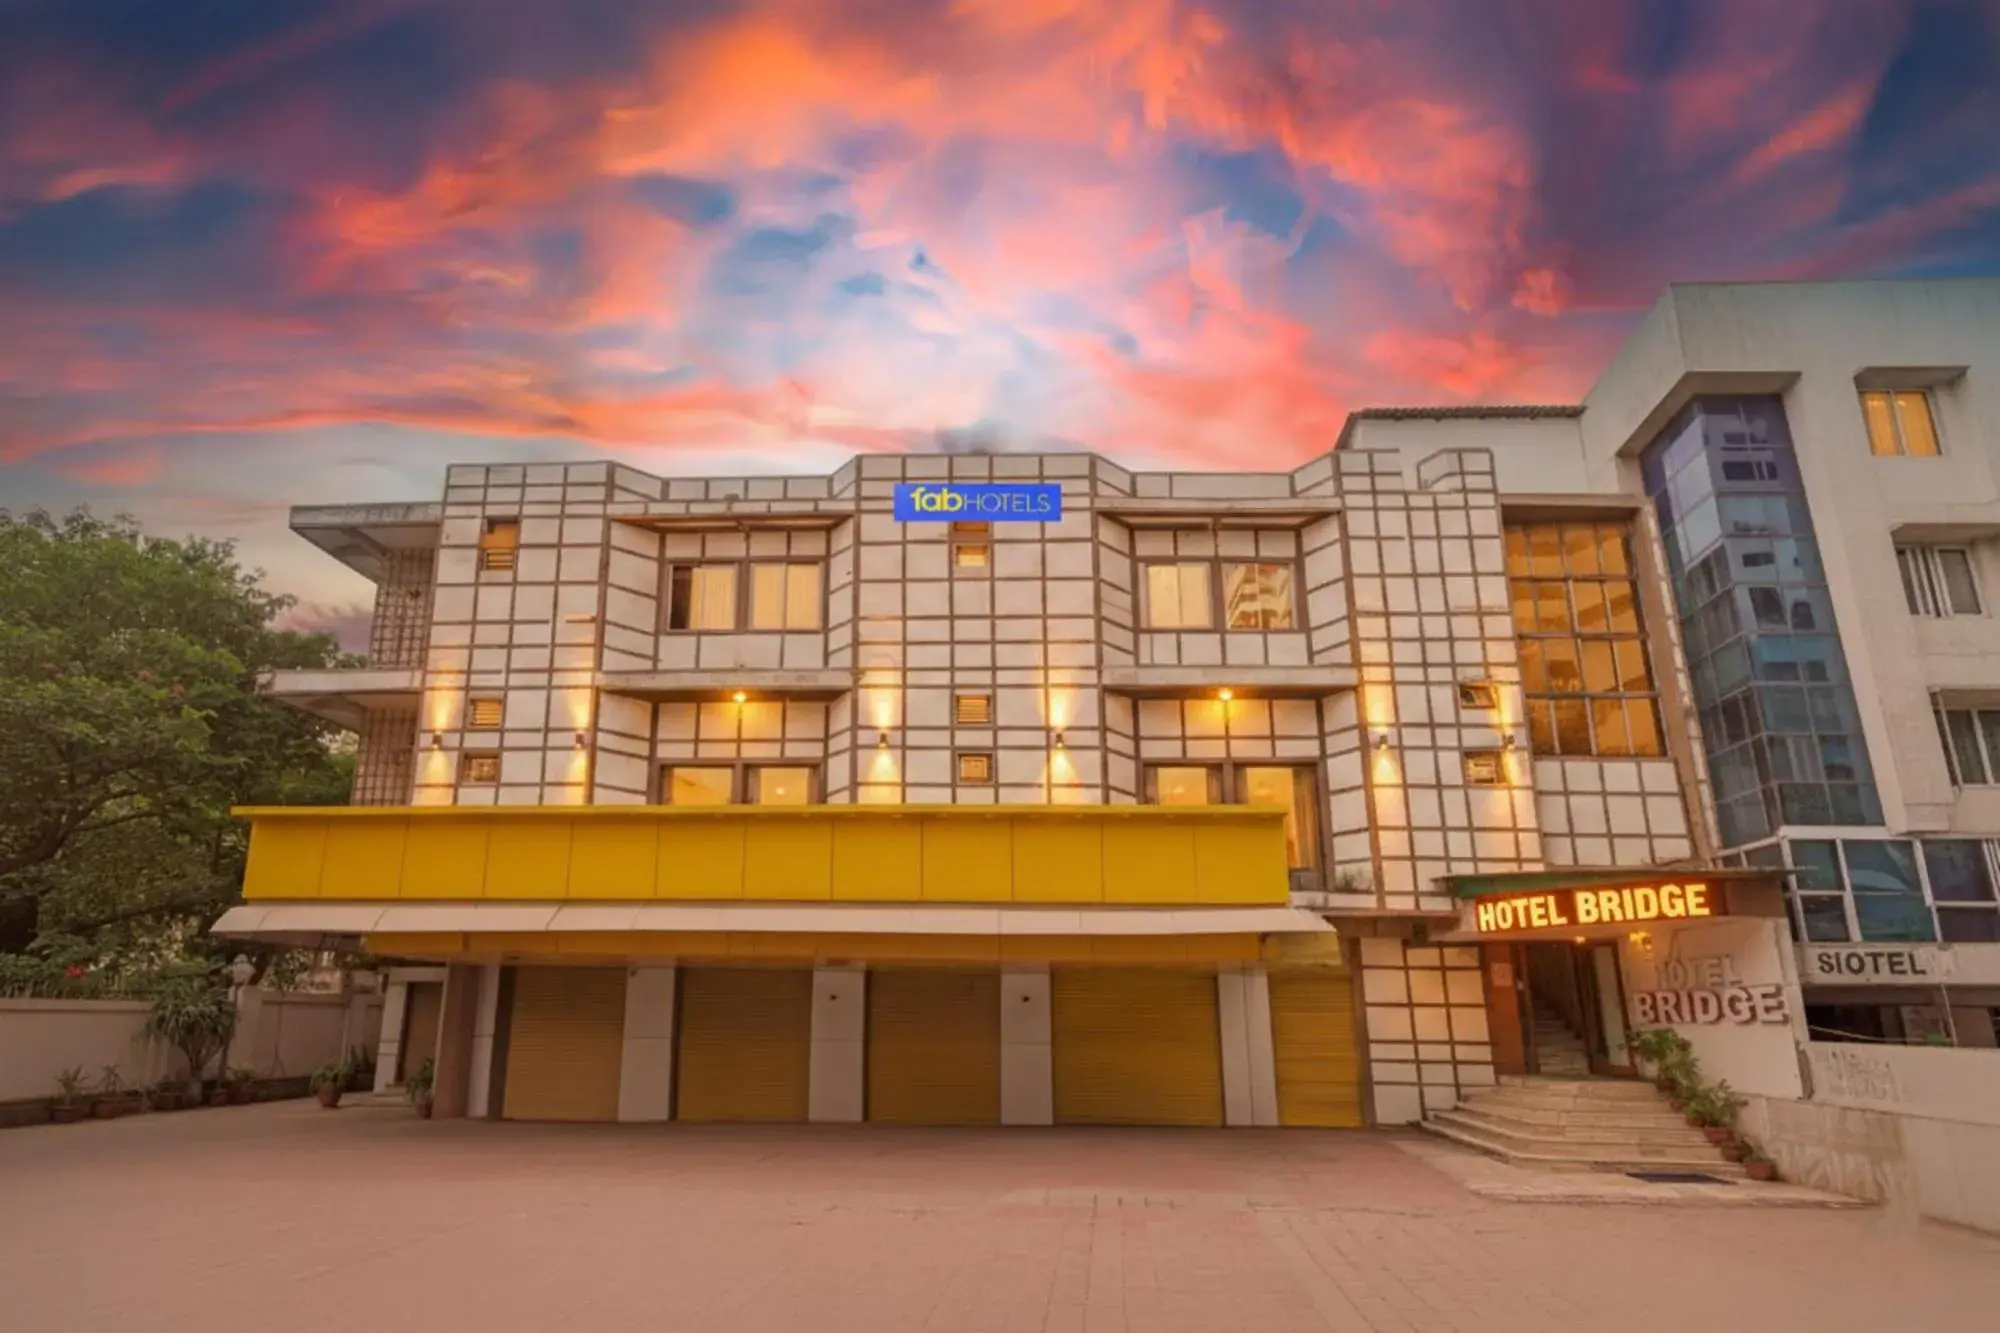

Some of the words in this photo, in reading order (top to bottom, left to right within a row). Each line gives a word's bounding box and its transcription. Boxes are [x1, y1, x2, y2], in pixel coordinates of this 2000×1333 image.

[1478, 895, 1568, 932] HOTEL
[1575, 884, 1710, 923] BRIDGE
[1817, 952, 1926, 975] SIOTEL
[1632, 983, 1789, 1025] BRIDGE
